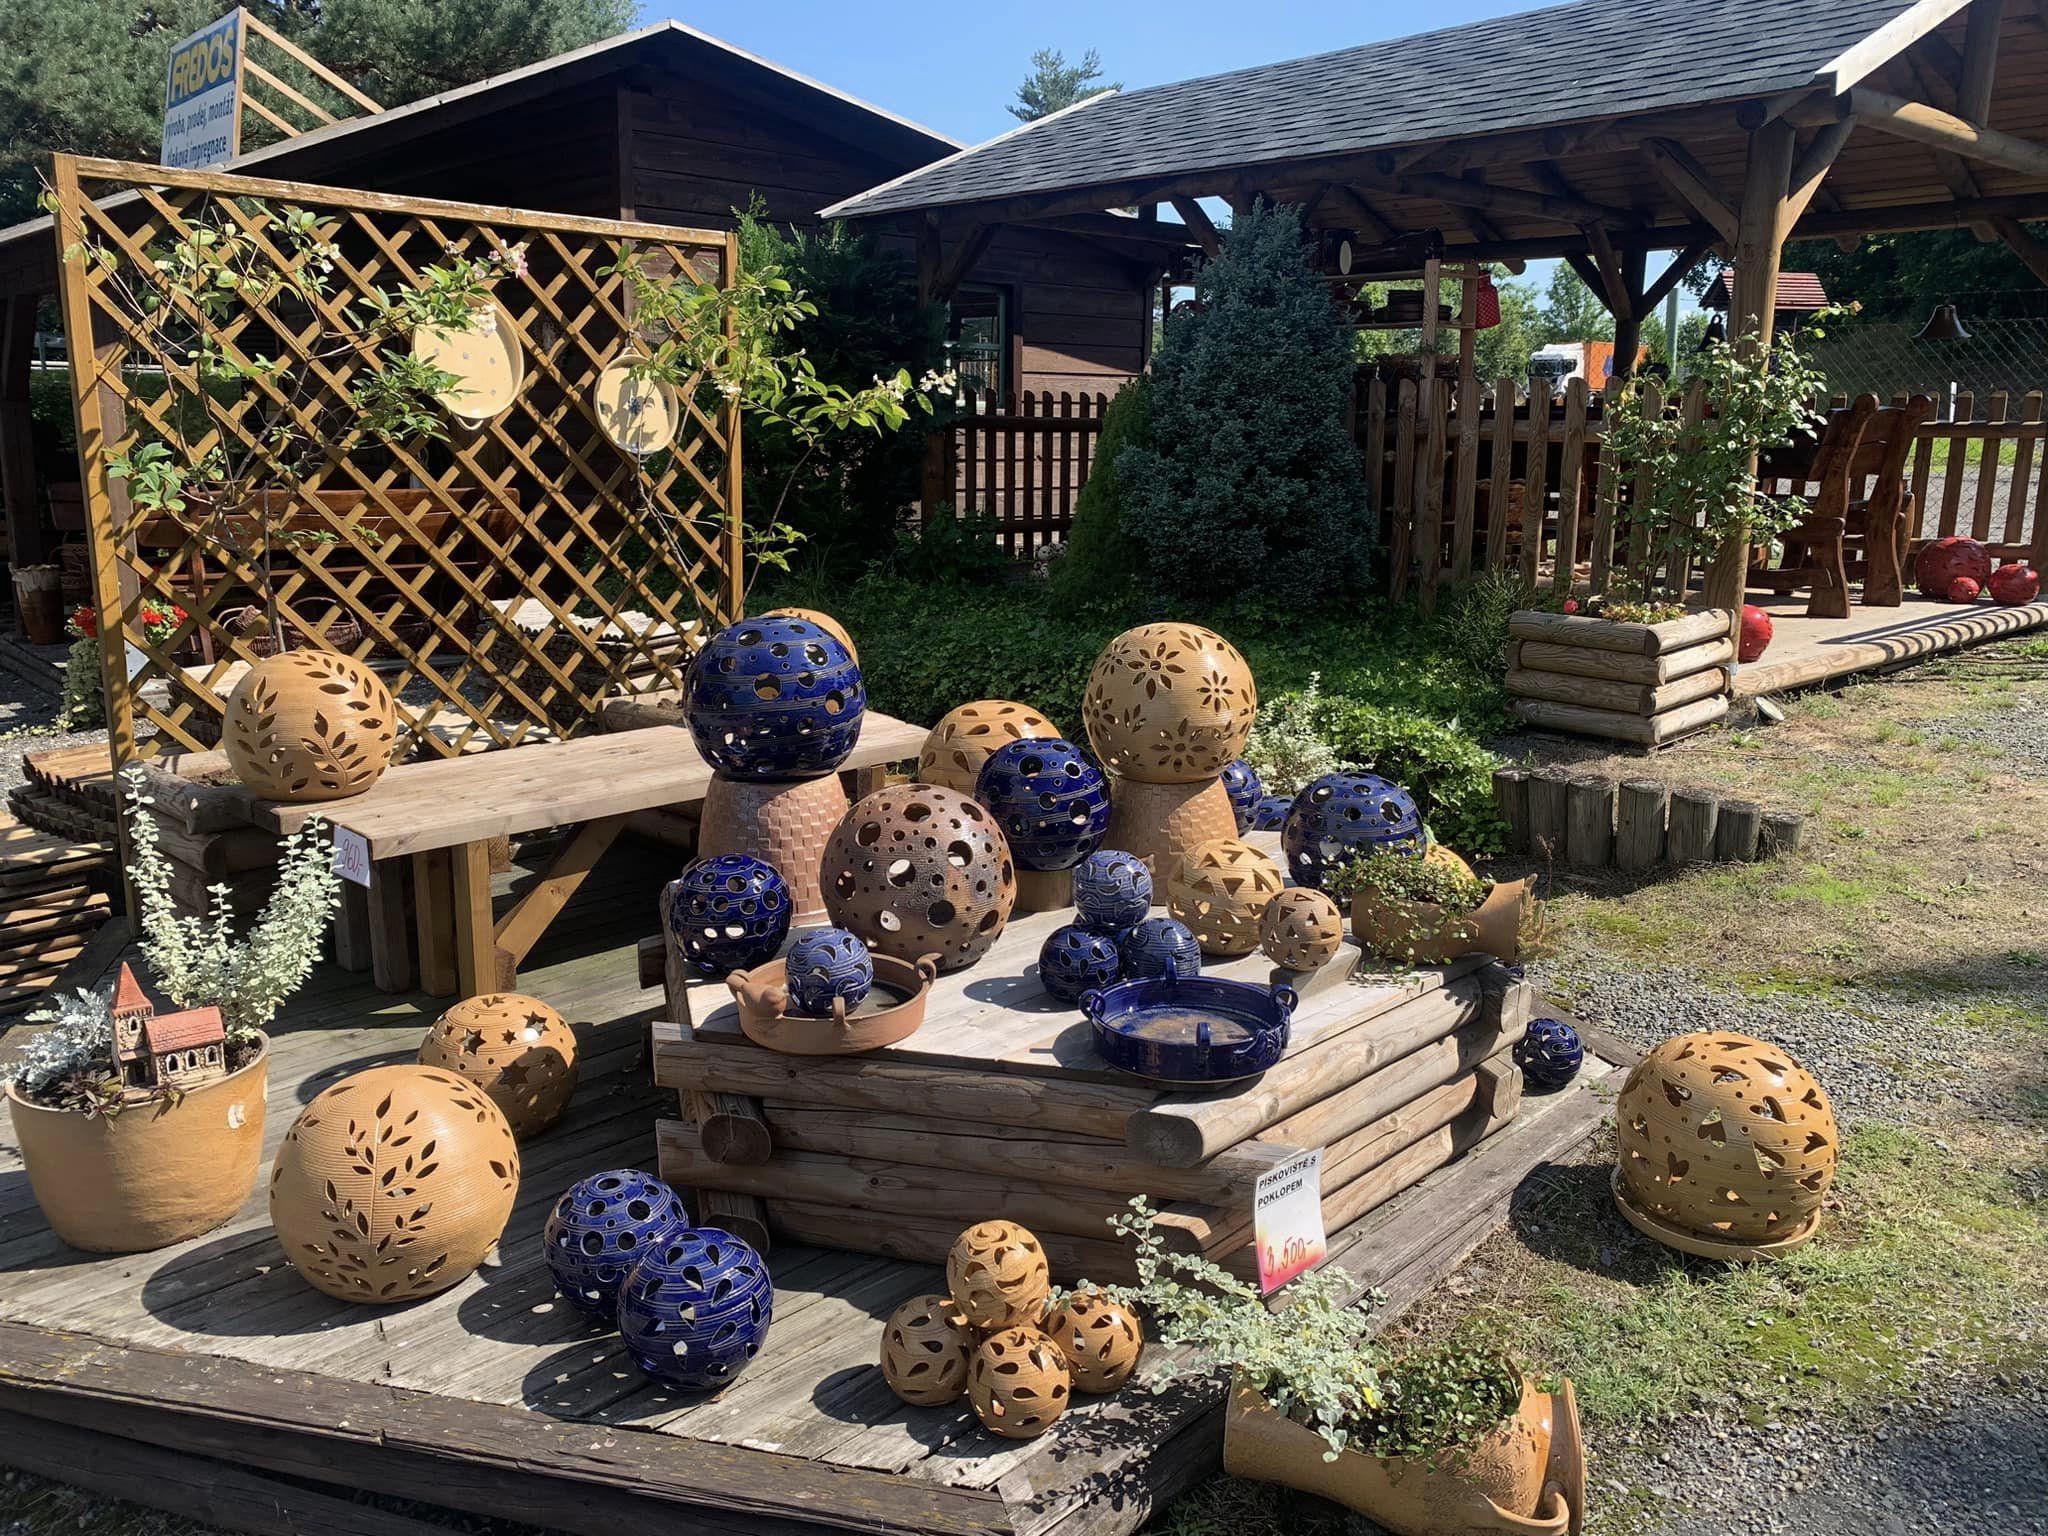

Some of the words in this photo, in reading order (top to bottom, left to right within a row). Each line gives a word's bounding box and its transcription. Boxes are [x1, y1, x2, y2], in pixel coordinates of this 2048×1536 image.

[170, 27, 234, 102] FREDOS
[165, 113, 185, 144] výroba,
[208, 91, 234, 122] montáž
[189, 135, 227, 169] impregnace
[1310, 1155, 1317, 1166] S
[1257, 1178, 1303, 1208] POKLOPEM
